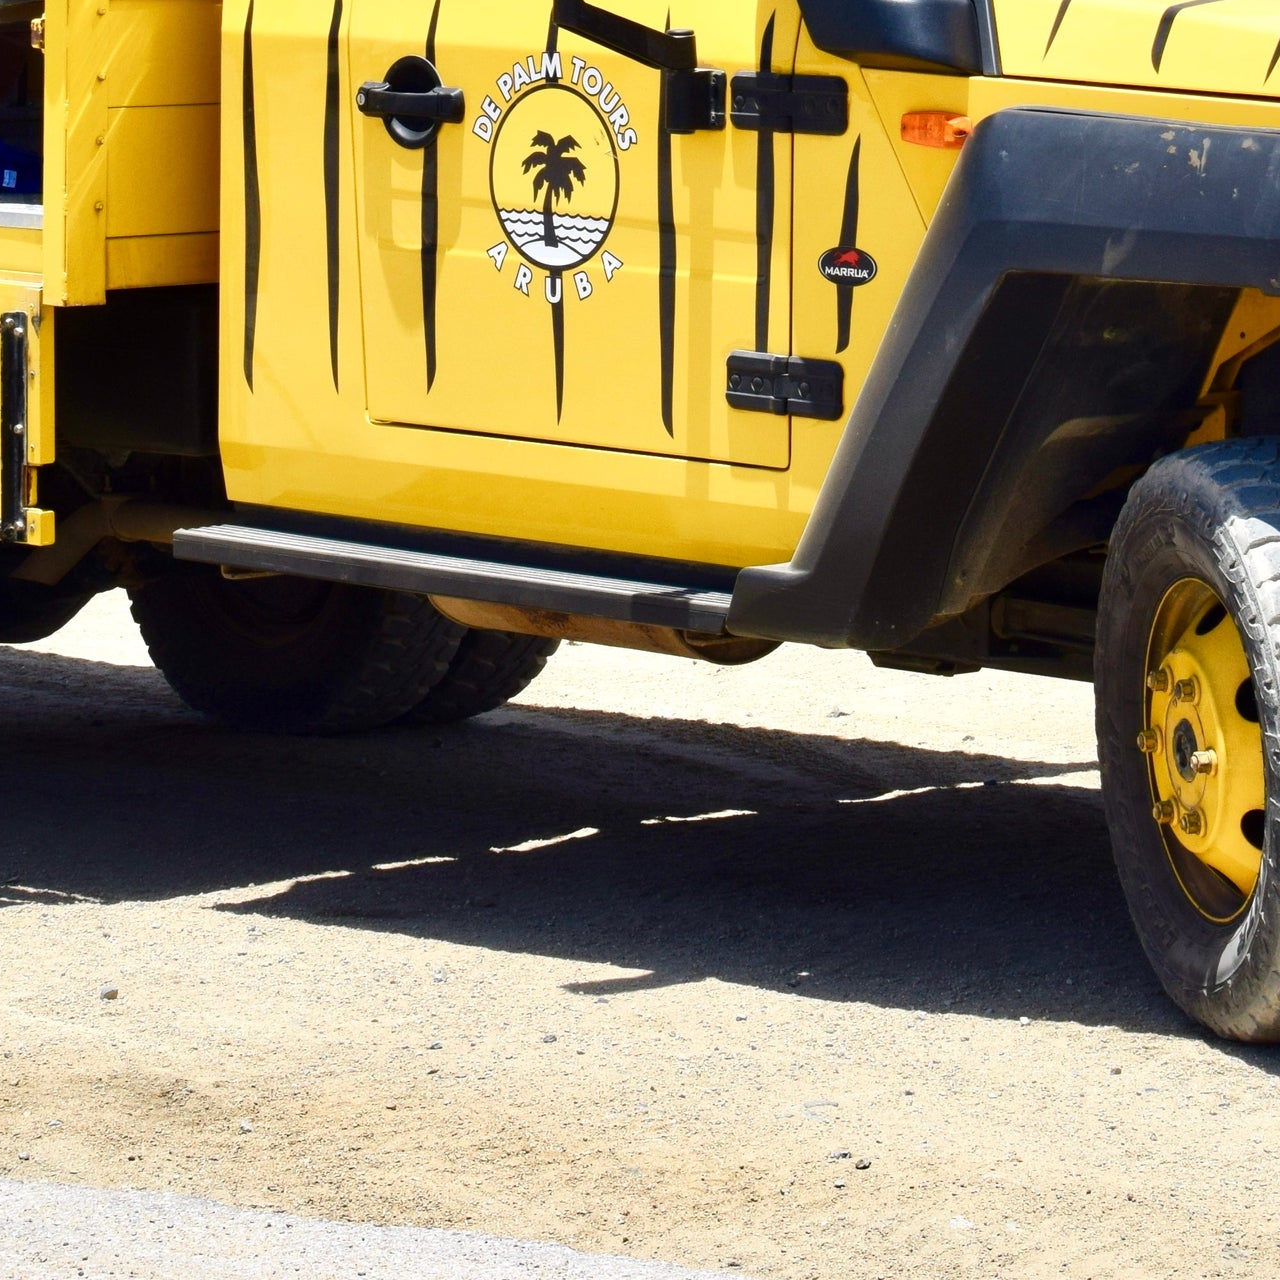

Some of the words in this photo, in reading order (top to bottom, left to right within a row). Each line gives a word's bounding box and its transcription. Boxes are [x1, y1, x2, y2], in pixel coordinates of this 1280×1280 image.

[472, 95, 501, 143] DE
[496, 51, 563, 102] PALM
[570, 56, 638, 151] TOURS
[486, 240, 623, 304] ARUBA
